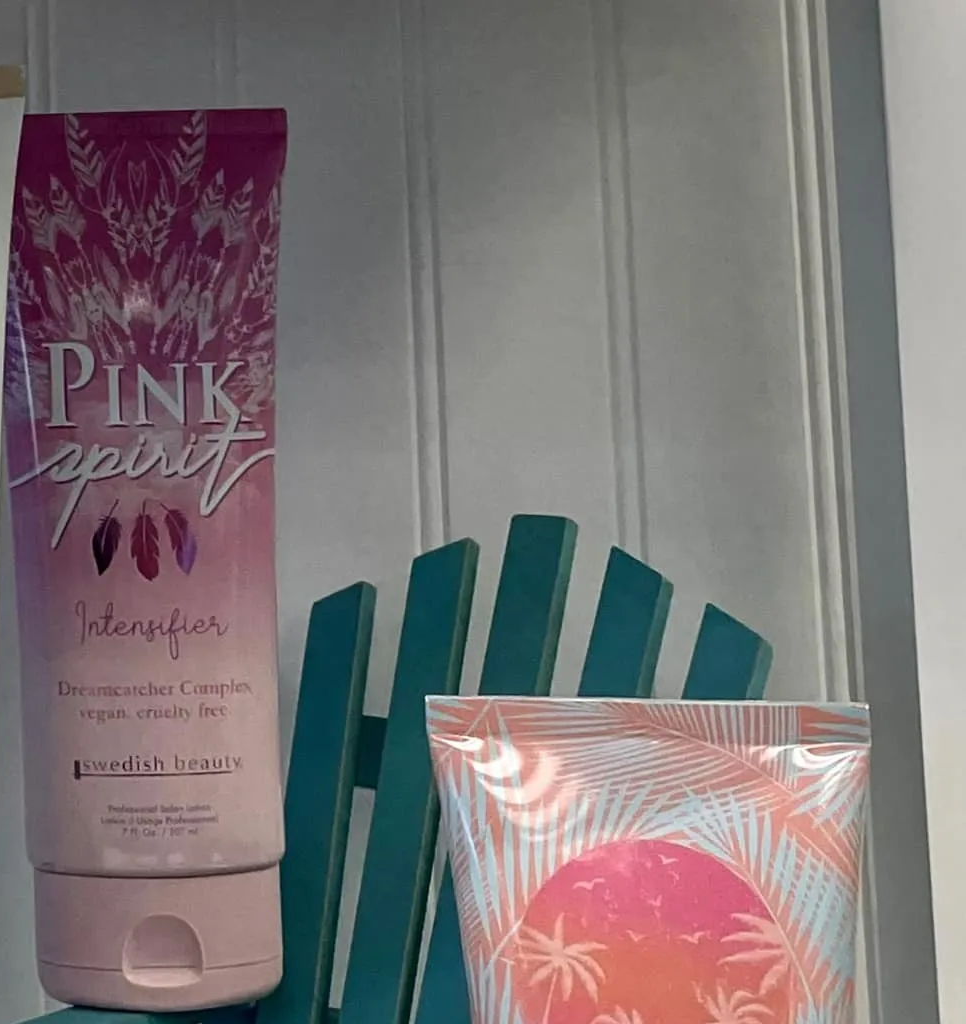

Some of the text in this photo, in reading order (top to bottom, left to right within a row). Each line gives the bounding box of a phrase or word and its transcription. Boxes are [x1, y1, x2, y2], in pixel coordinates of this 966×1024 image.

[41, 342, 253, 429] PINK
[9, 412, 275, 551] spirit
[75, 601, 229, 660] Intensifier
[58, 680, 253, 699] Dreamcatcher Complex
[136, 704, 192, 721] cruelty
[83, 756, 165, 772] swedish
